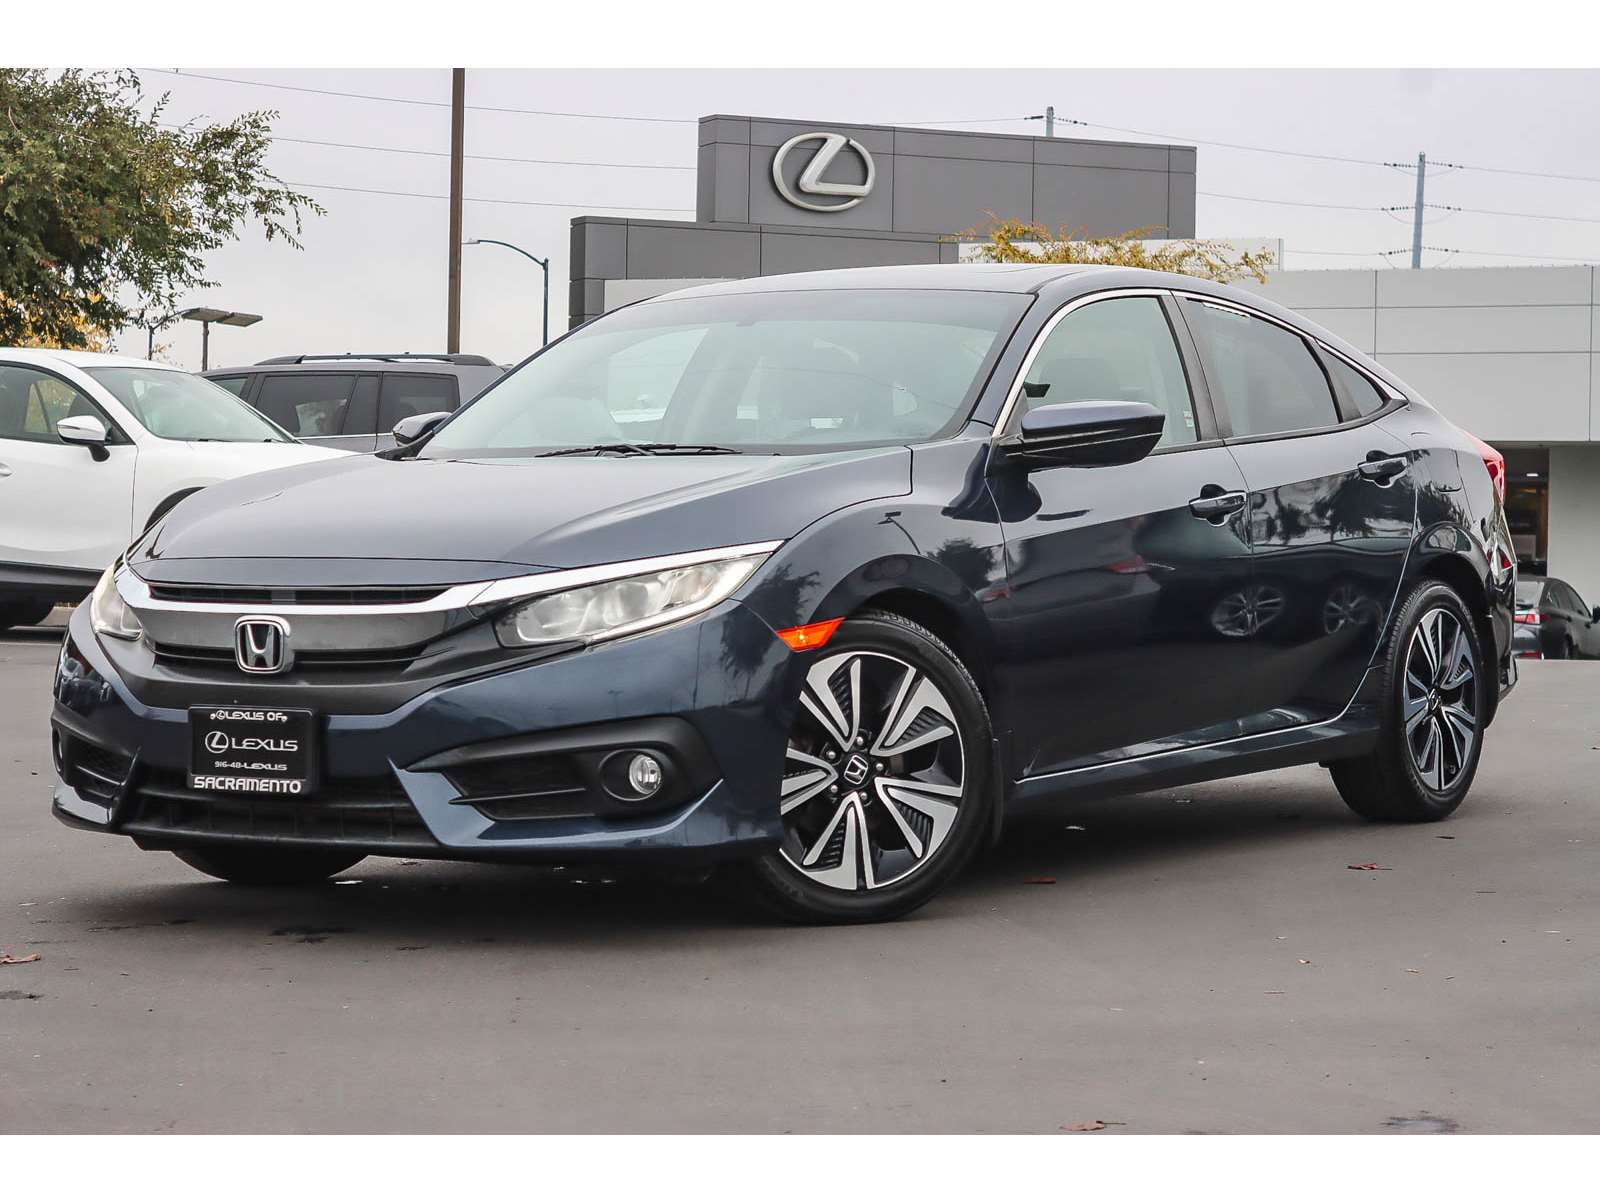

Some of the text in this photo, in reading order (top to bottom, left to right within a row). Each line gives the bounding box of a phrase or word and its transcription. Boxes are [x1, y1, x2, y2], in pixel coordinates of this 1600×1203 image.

[225, 711, 283, 721] LEXUS OF
[231, 737, 299, 752] LEXUS
[193, 776, 302, 794] SACRAMENTO
